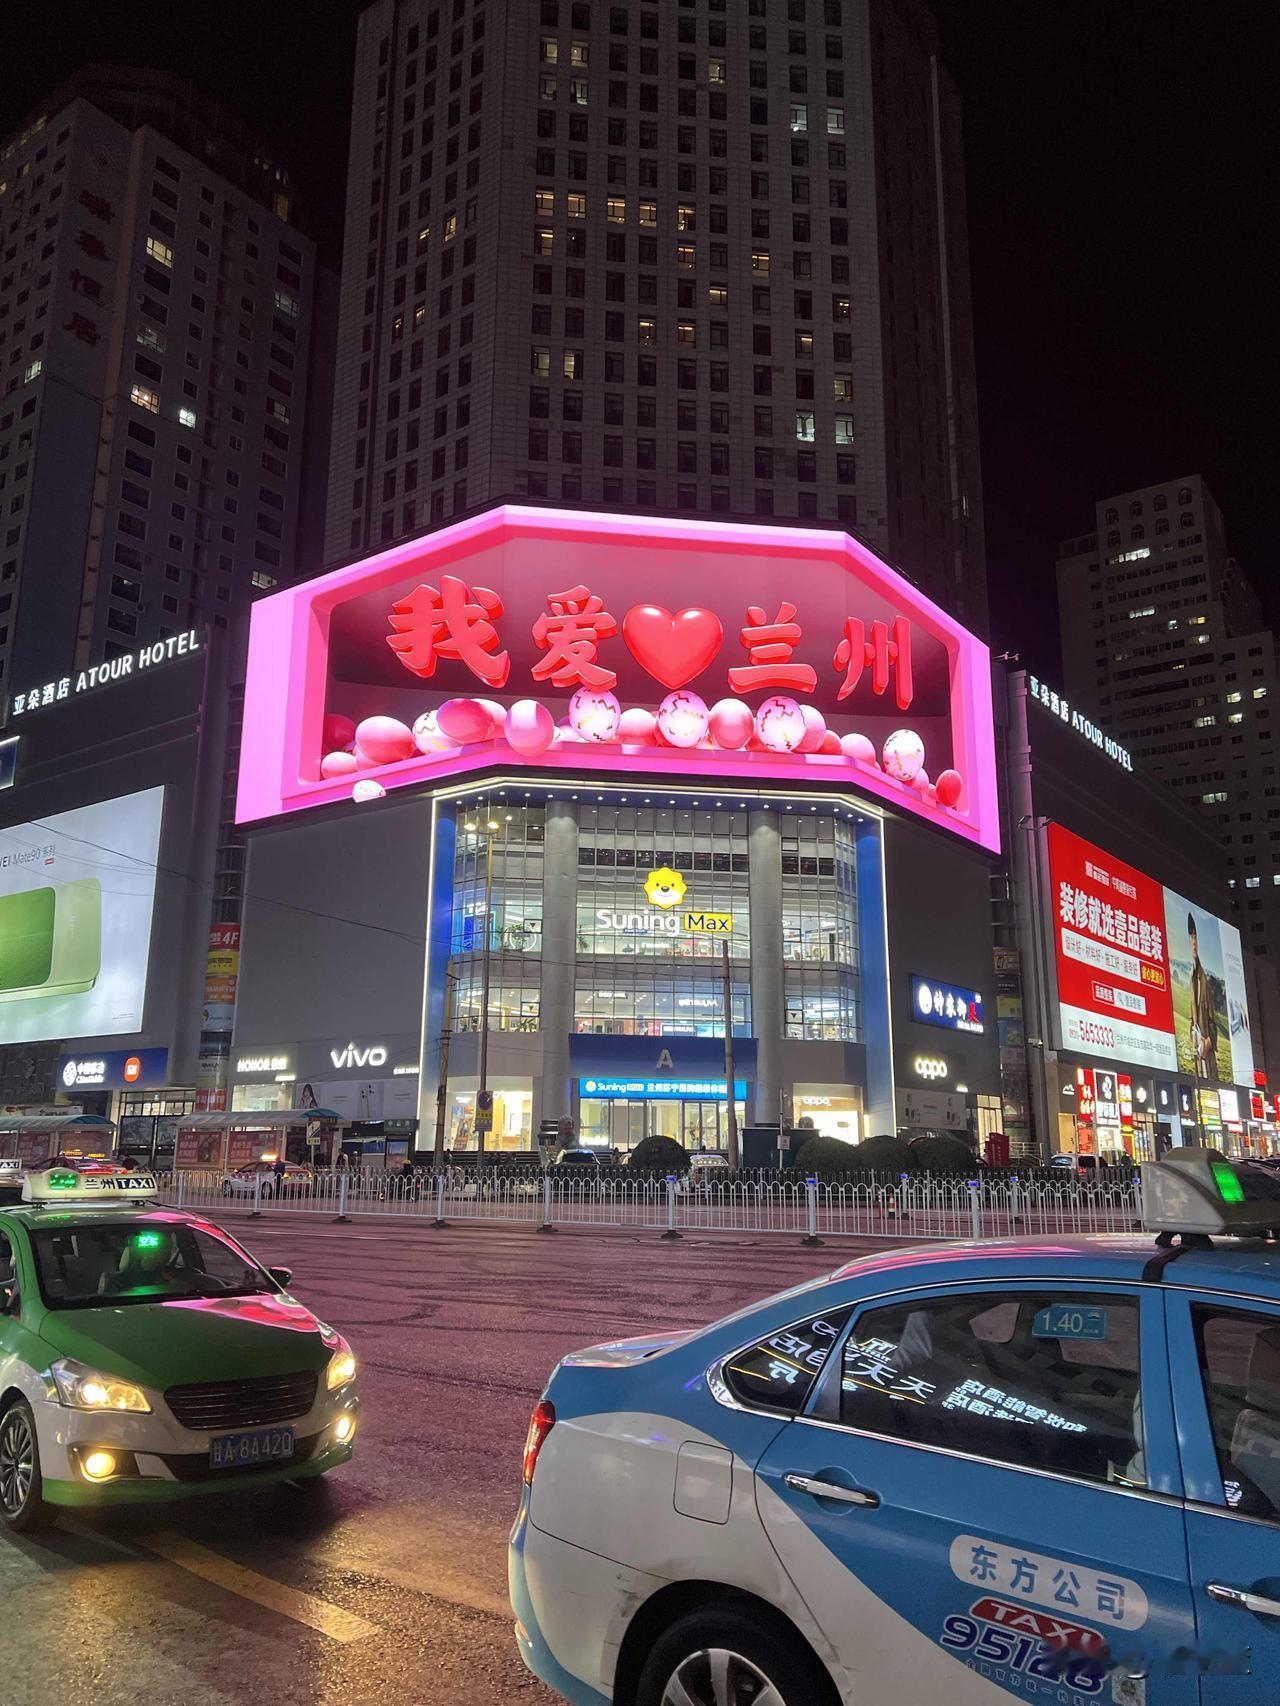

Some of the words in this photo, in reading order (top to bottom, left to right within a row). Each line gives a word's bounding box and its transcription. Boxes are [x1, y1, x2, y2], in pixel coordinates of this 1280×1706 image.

[387, 574, 617, 691] 我爱
[728, 602, 914, 710] 兰州
[13, 677, 71, 716] 亚朵酒店
[76, 654, 134, 692] ATOUR
[139, 629, 200, 669] HOTEL
[1030, 675, 1069, 722] 亚朵酒店
[1072, 710, 1103, 749] ATOUR
[1105, 736, 1134, 772] HOTEL
[596, 908, 680, 937] Suning
[687, 914, 730, 931] Max
[1060, 881, 1164, 963] 装修就选壹品整装
[1079, 1020, 1115, 1049] 5653333
[330, 1042, 386, 1069] vivo
[656, 1048, 674, 1069] A
[597, 1082, 627, 1093] Suning
[85, 1178, 116, 1190] 兰州
[117, 1177, 153, 1189] TAXI
[1042, 1311, 1083, 1333] 1.40
[969, 1544, 1127, 1621] 东方公司
[990, 1602, 1094, 1648] TAXI
